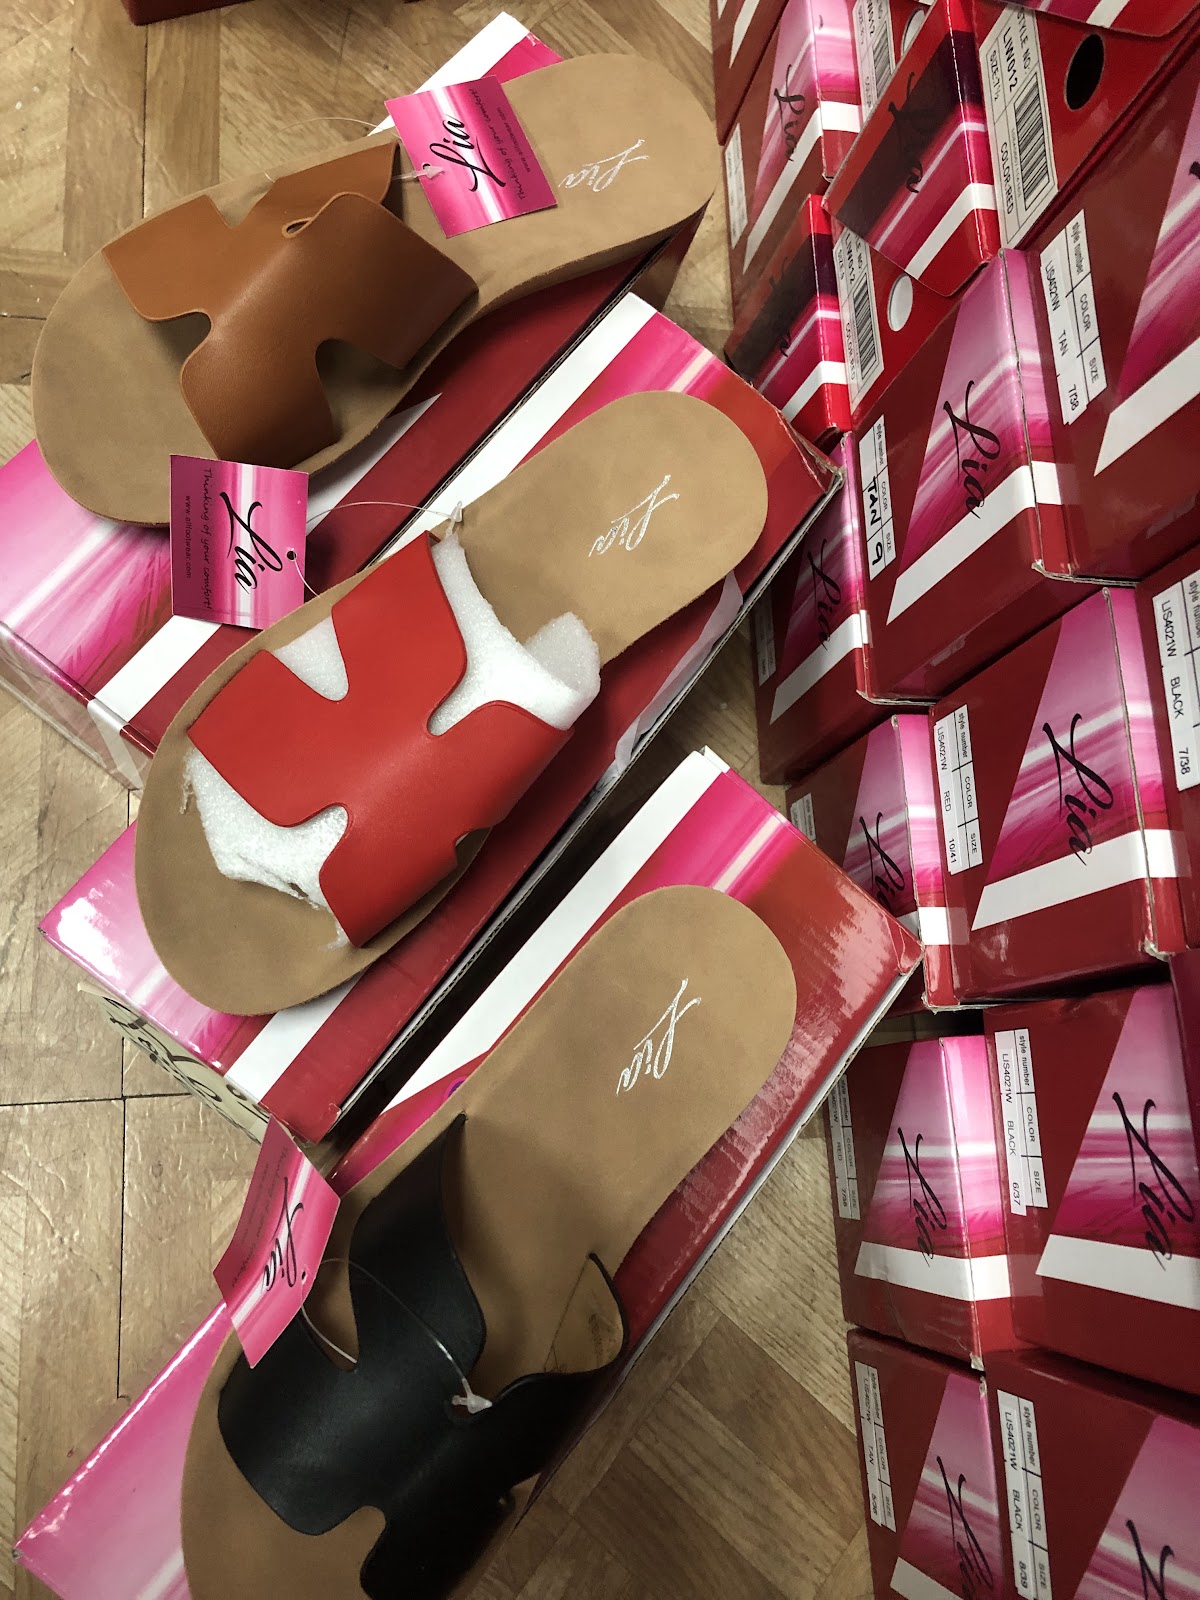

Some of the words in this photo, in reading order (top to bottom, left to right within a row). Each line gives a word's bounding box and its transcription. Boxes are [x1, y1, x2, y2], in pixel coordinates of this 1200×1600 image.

[1003, 27, 1018, 93] LIW012
[430, 114, 507, 192] Lia
[1071, 221, 1080, 243] style
[845, 233, 857, 285] LIW012
[1074, 243, 1085, 275] number
[1045, 260, 1061, 312] LIS4021W
[1057, 329, 1069, 357] TAN
[1068, 384, 1080, 411] 7/38
[1079, 293, 1091, 332] COLOR
[1089, 357, 1100, 383] SIZE
[943, 380, 1001, 519] Lia
[200, 467, 212, 521] Thinking
[868, 476, 882, 527] TAN
[200, 537, 212, 563] your
[201, 524, 212, 536] of
[219, 492, 283, 595] Lia
[872, 541, 883, 566] 9
[201, 567, 212, 610] comfort!
[1161, 600, 1177, 657] LIS4021W
[1170, 676, 1185, 720] BLACK
[1179, 747, 1191, 775] 7/38
[959, 732, 968, 758] number
[937, 726, 948, 771] LIS4021W
[949, 838, 957, 864] 10/41
[1042, 713, 1114, 866] Lia
[1002, 1053, 1012, 1103] LIS4021W
[1007, 1120, 1016, 1156] BLACK
[1012, 1182, 1021, 1206] 6/37
[1022, 1057, 1030, 1086] number
[1026, 1106, 1035, 1143] COLOR
[1033, 1170, 1041, 1194] SIZE
[1024, 1406, 1032, 1428] style
[1027, 1431, 1036, 1467] number
[1005, 1411, 1018, 1471] LIS4021W
[1012, 1489, 1023, 1532] BLACK
[1018, 1560, 1028, 1589] 8/39
[1032, 1488, 1042, 1531] COLOR
[1038, 1562, 1047, 1590] SIZE
